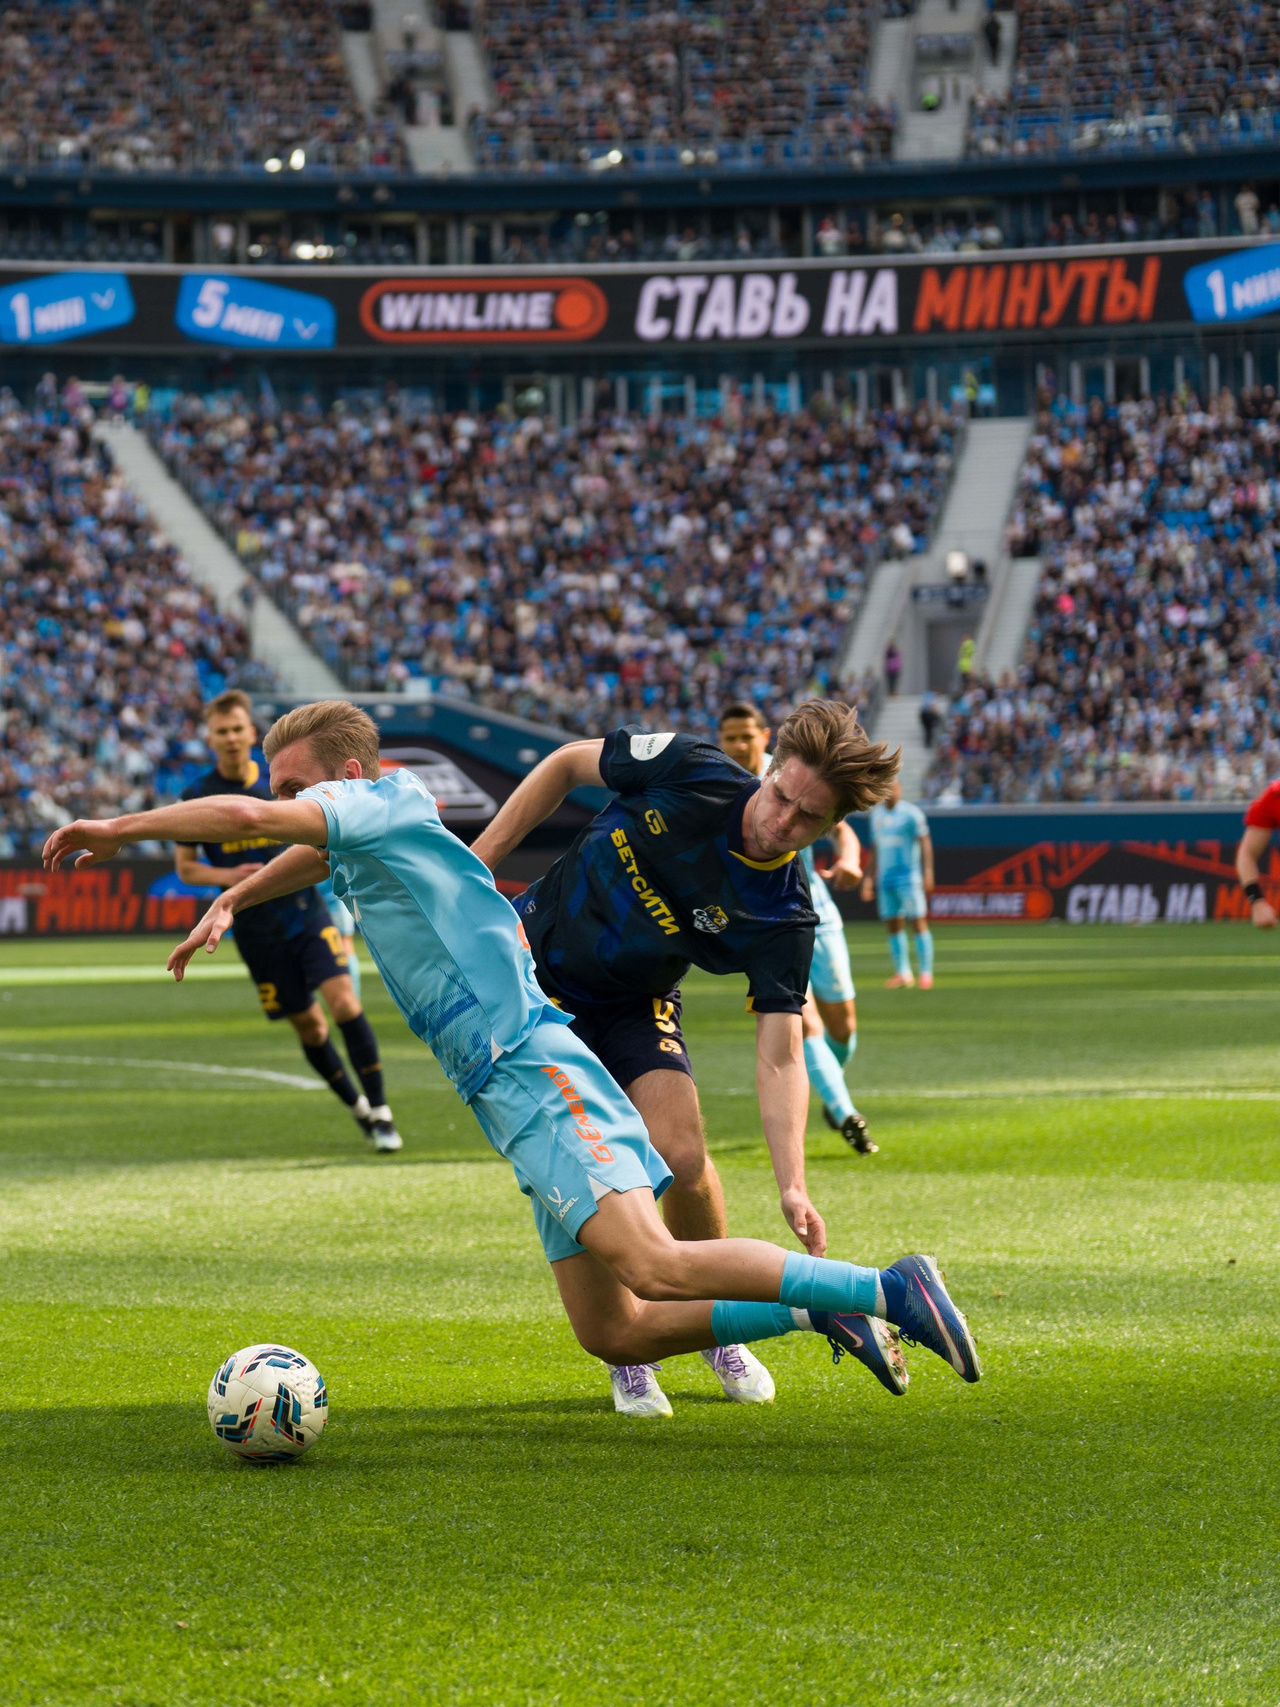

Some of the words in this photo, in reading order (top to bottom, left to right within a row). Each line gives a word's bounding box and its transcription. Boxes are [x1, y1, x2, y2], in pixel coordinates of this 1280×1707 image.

[10, 292, 32, 341] 1
[192, 279, 230, 328] 5
[380, 292, 555, 330] WINLINE
[634, 274, 810, 342] СТАВЬ
[822, 268, 899, 336] НА
[913, 256, 1162, 333] МИНУТЫ
[1206, 269, 1227, 320] 1
[610, 828, 680, 936] БЕТСИТИ
[1065, 884, 1160, 924] СТАВЬ
[1165, 882, 1208, 923] НА
